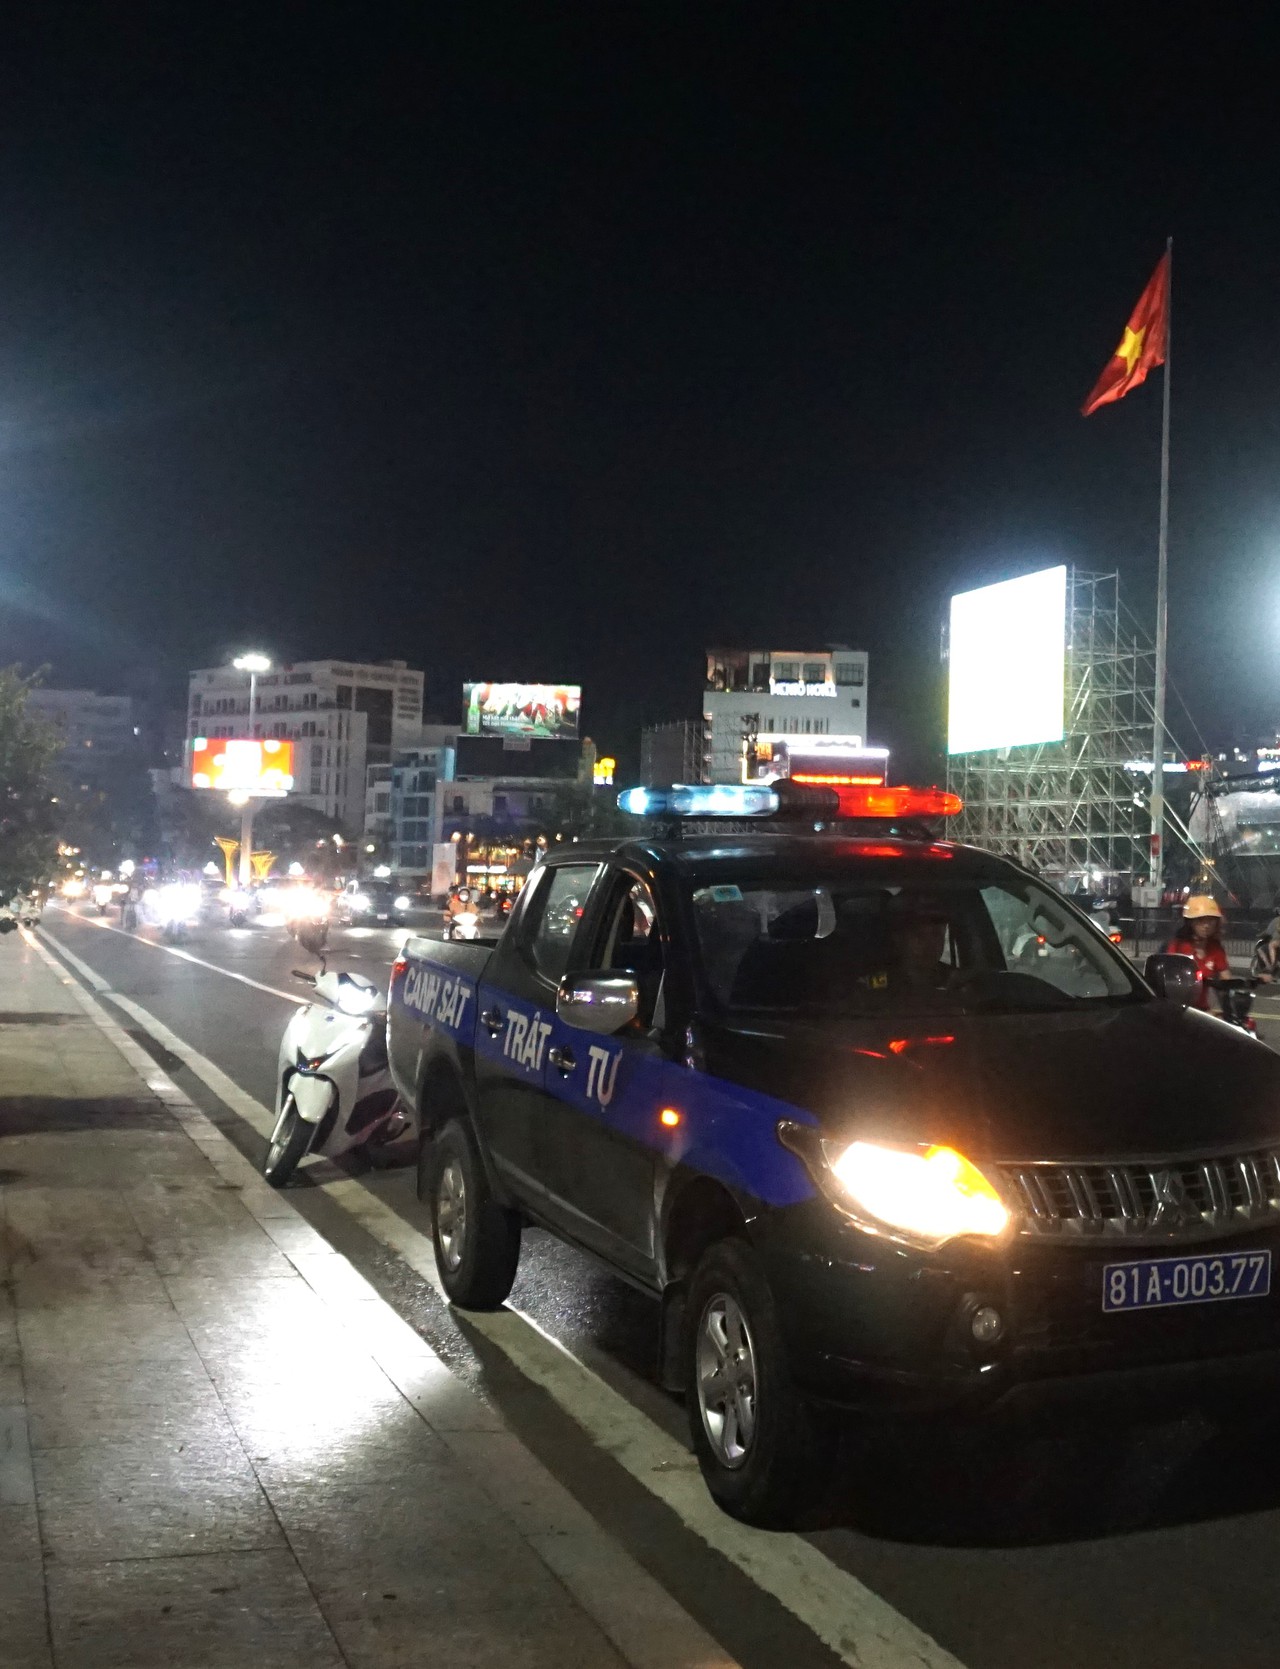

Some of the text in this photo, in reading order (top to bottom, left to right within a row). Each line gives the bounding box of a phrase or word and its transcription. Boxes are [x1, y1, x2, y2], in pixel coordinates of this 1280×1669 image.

[436, 976, 471, 1030] SÁT
[503, 1009, 553, 1073] TRẬT
[1110, 1256, 1265, 1306] 81A-003.77
